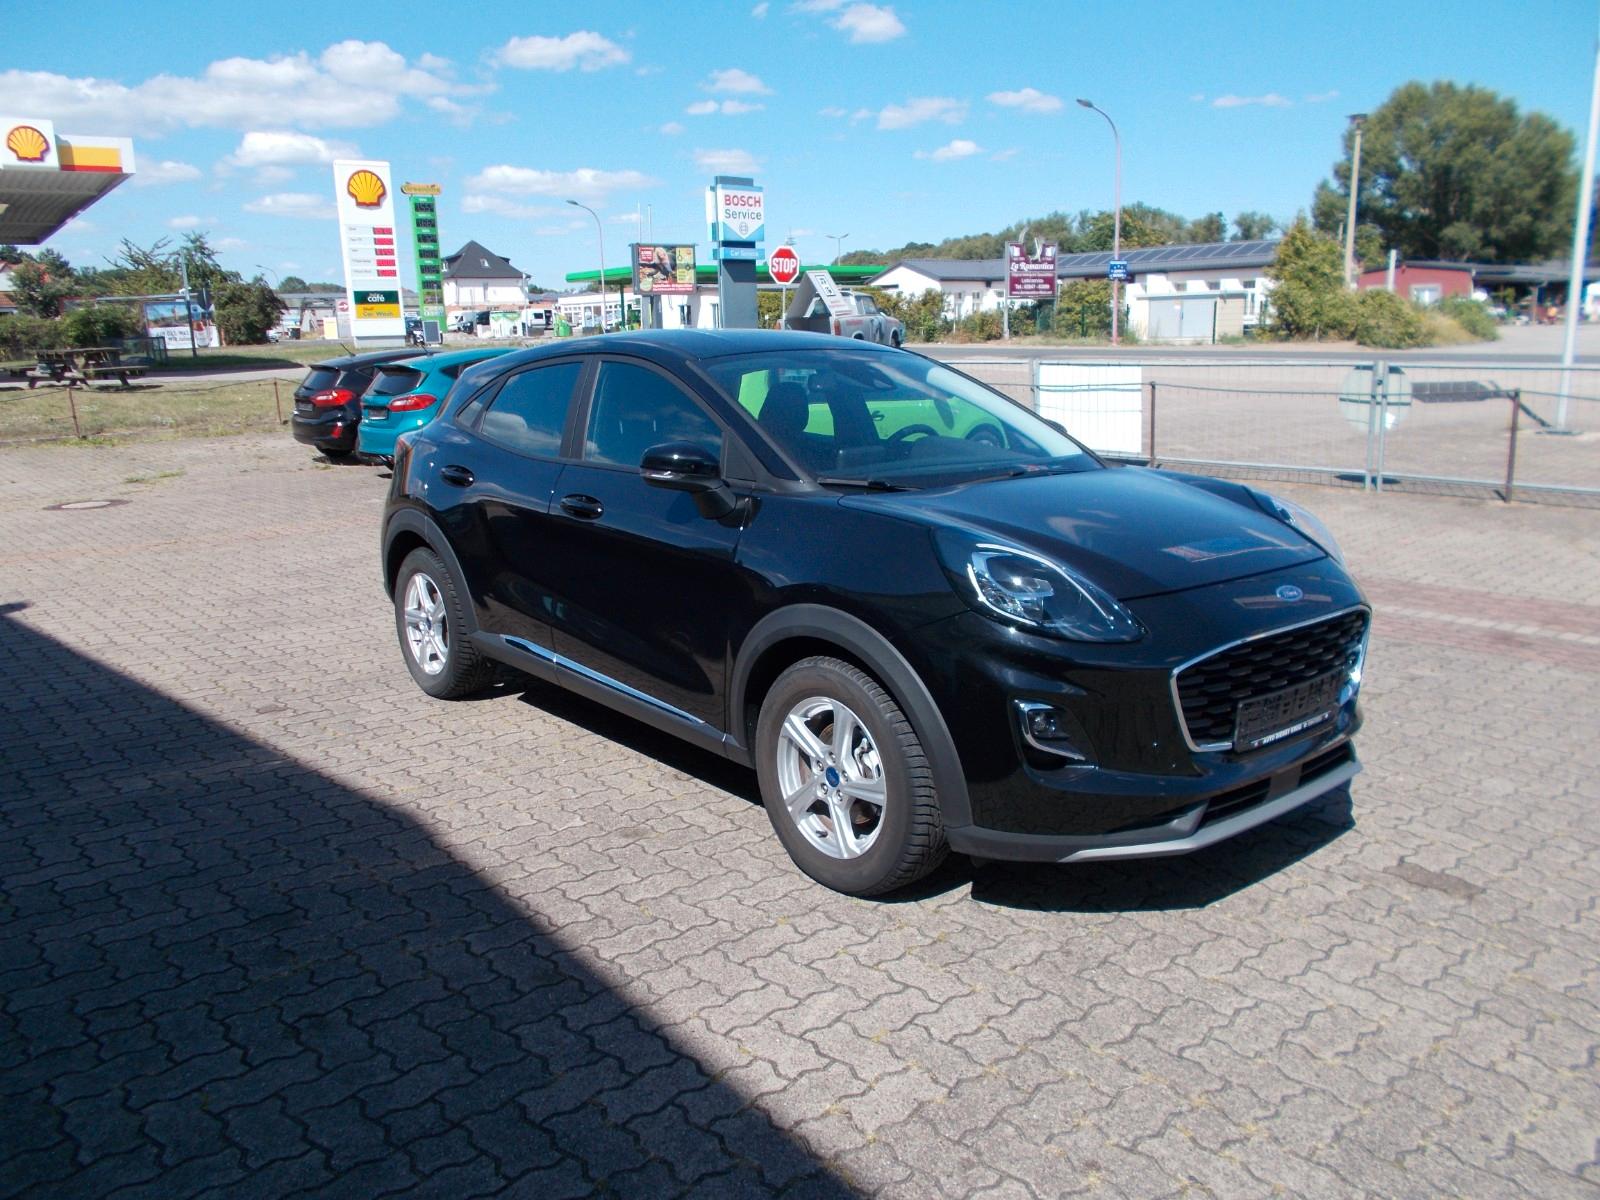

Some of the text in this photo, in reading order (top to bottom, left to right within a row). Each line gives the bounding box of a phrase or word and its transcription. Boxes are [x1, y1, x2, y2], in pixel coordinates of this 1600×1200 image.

[724, 194, 761, 207] BOSCH
[724, 208, 762, 220] Service
[772, 257, 797, 273] STOP
